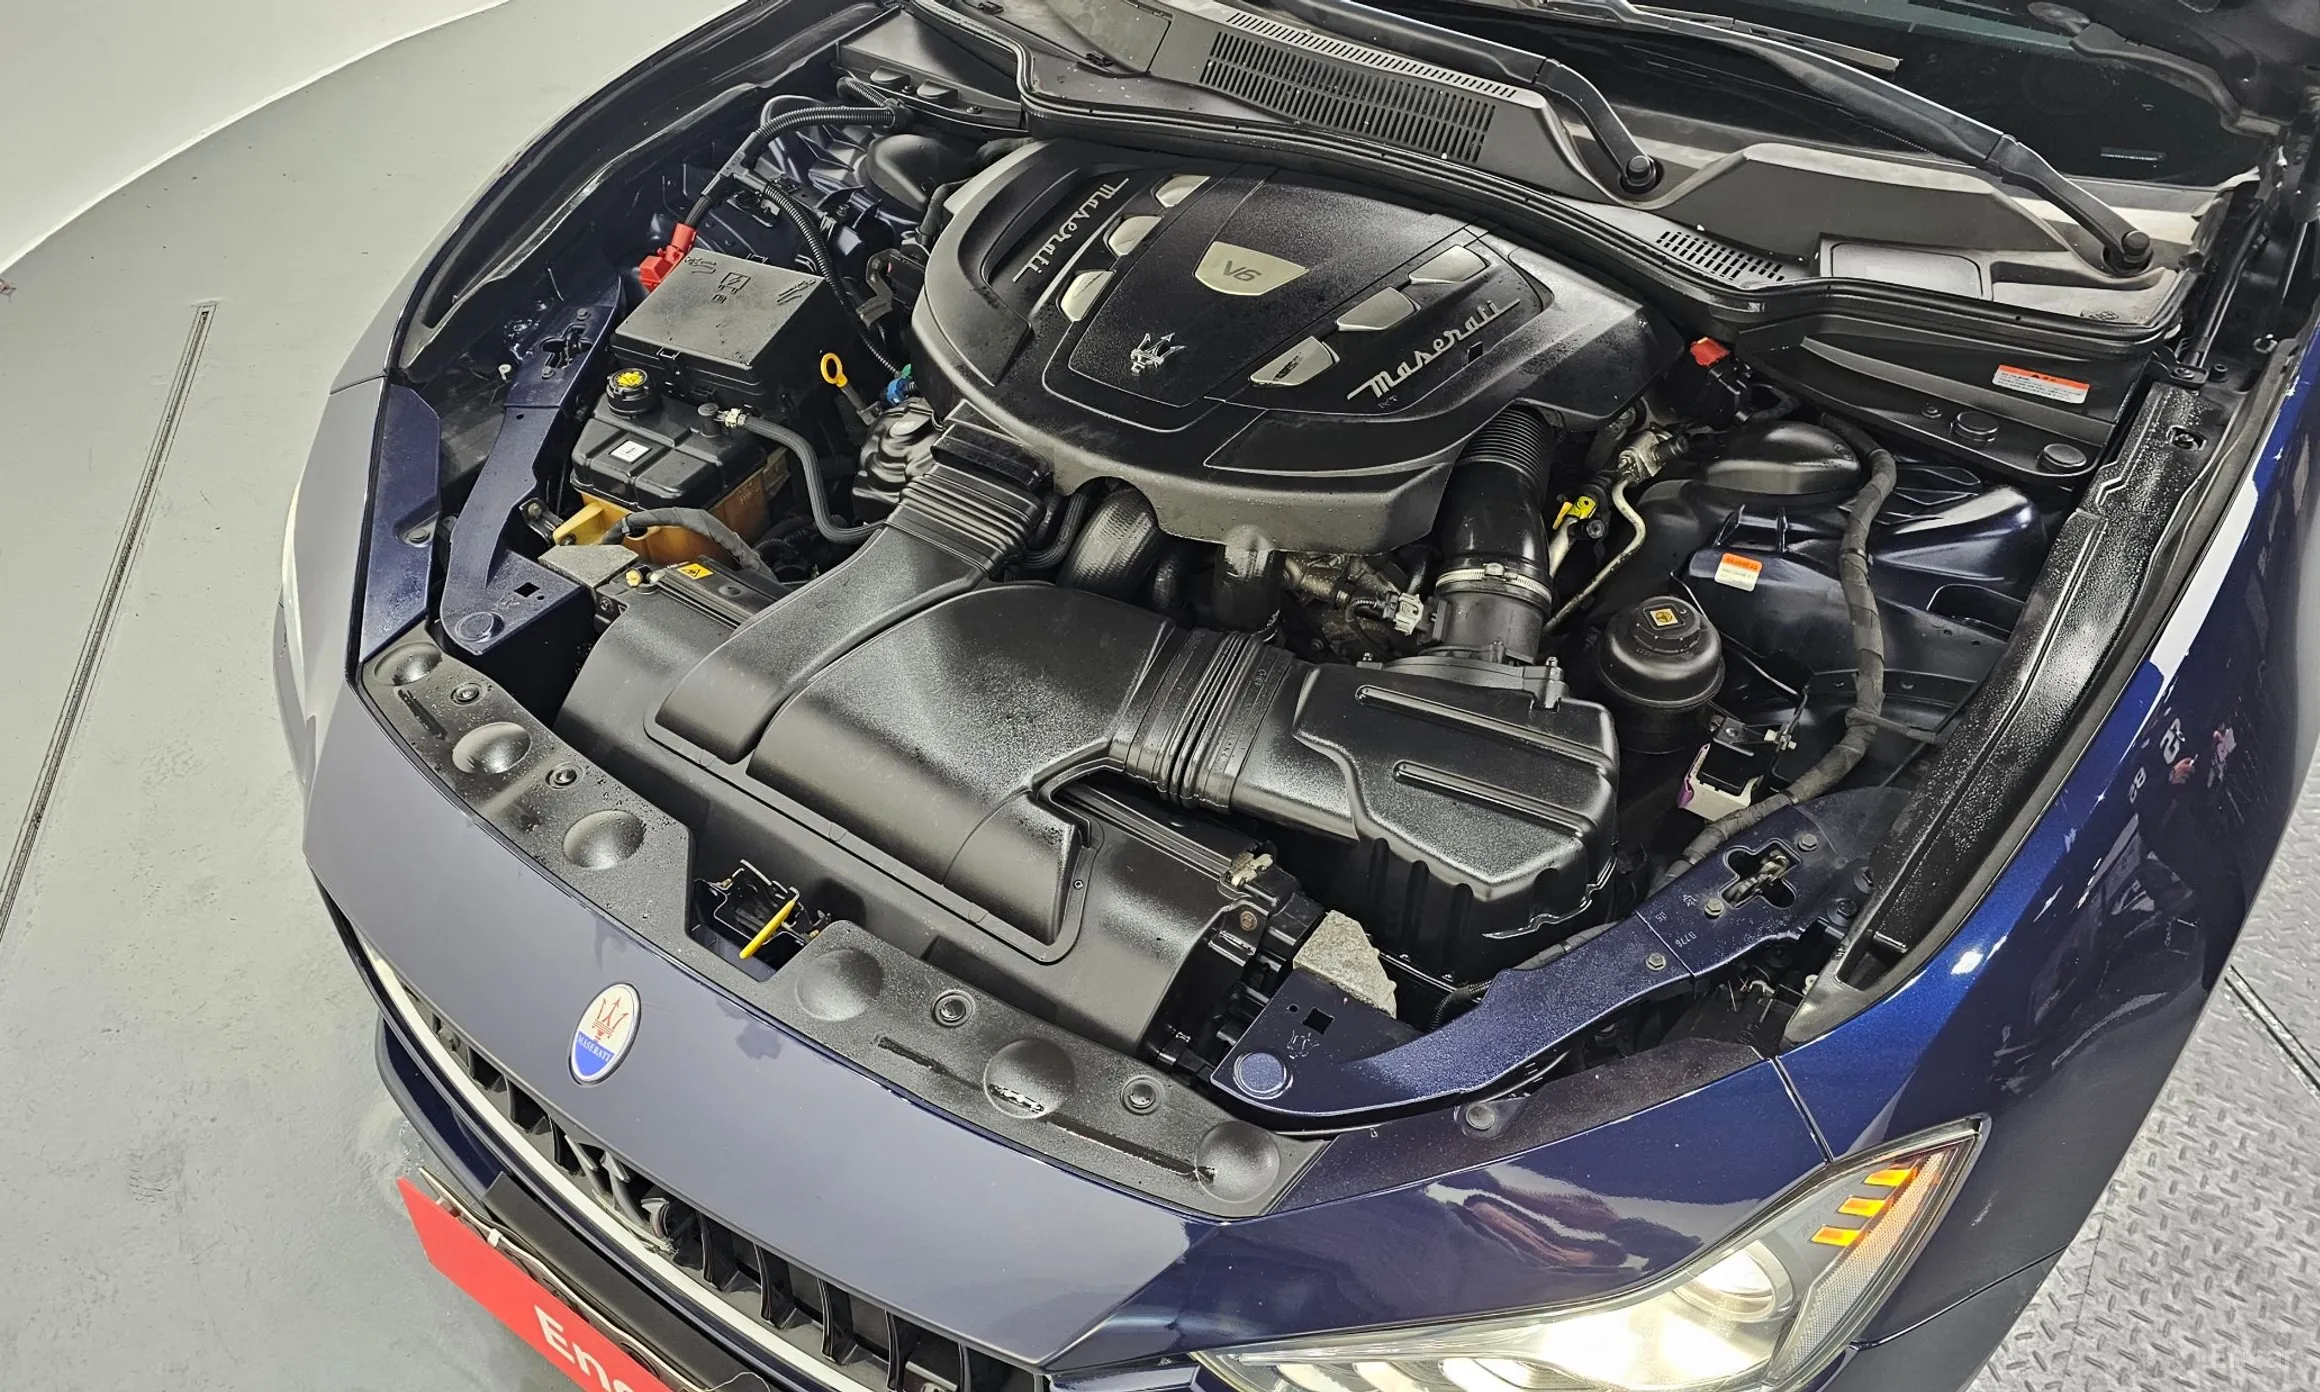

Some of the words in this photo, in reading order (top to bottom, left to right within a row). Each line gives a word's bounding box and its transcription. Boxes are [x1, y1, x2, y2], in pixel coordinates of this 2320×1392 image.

[1012, 178, 1130, 282] Maserati
[1223, 260, 1262, 282] V6
[1347, 299, 1521, 400] Maserati
[577, 1034, 612, 1062] MASERATI
[534, 1304, 635, 1392] En
